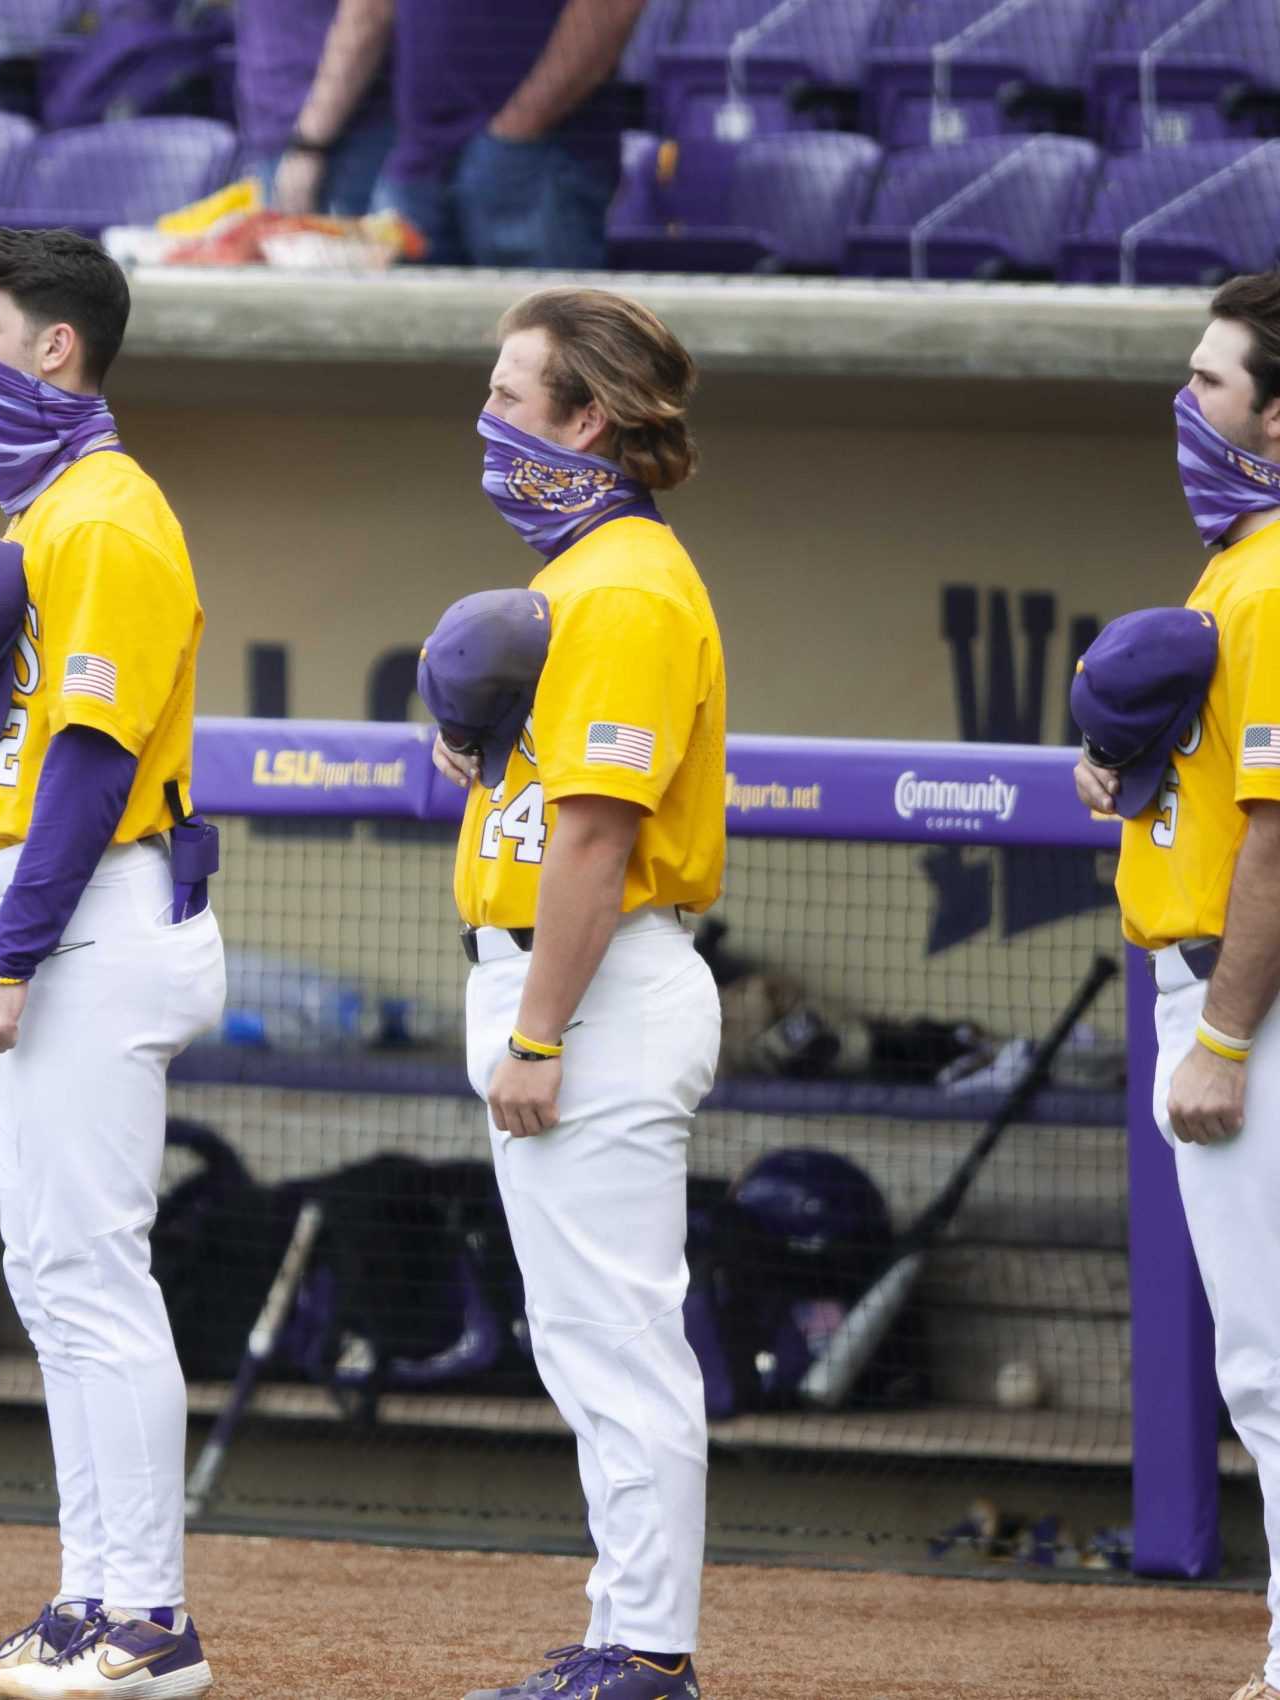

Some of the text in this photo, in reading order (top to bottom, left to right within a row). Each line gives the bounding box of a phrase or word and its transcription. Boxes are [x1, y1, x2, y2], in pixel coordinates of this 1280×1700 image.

[894, 771, 1017, 820] Community
[480, 779, 548, 864] 24
[926, 817, 982, 831] COFFEE
